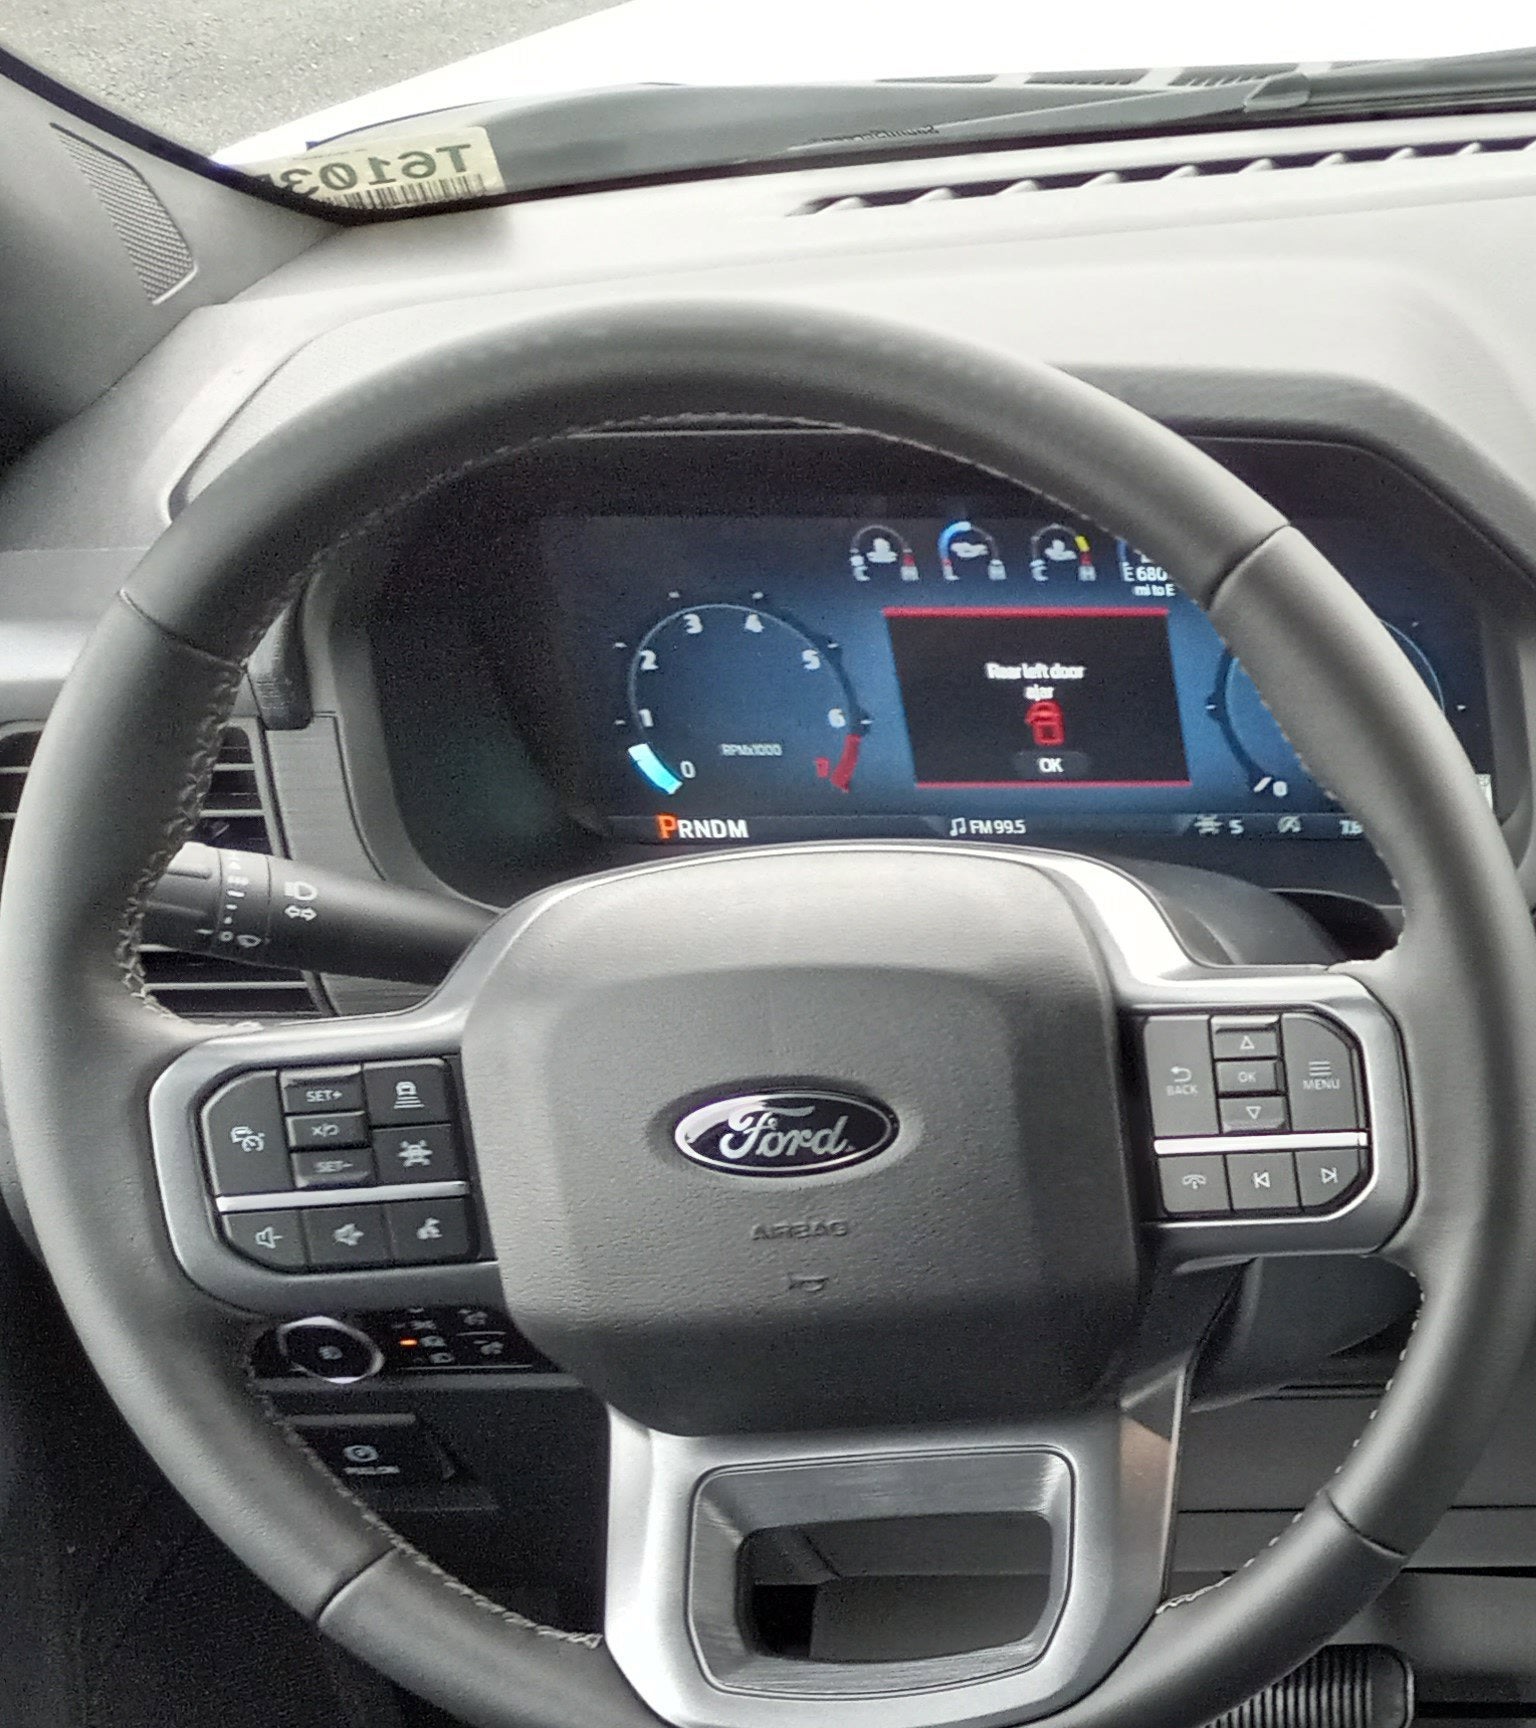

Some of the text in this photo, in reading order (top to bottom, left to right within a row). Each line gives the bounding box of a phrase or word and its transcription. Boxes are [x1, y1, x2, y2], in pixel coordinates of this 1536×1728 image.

[684, 614, 702, 634] 3
[744, 614, 764, 633] 4
[640, 650, 659, 670] 2
[802, 649, 821, 670] 5
[986, 662, 1021, 679] Rear
[1050, 662, 1086, 679] door
[638, 709, 654, 727] 1
[828, 708, 846, 728] 6
[680, 760, 696, 778] 0
[1038, 757, 1064, 773] OK
[969, 819, 1026, 834] FM 99.5
[1238, 1071, 1257, 1083] OK
[1303, 1079, 1341, 1090] MENU
[1166, 1084, 1198, 1096] BACK
[719, 1102, 849, 1159] Ford
